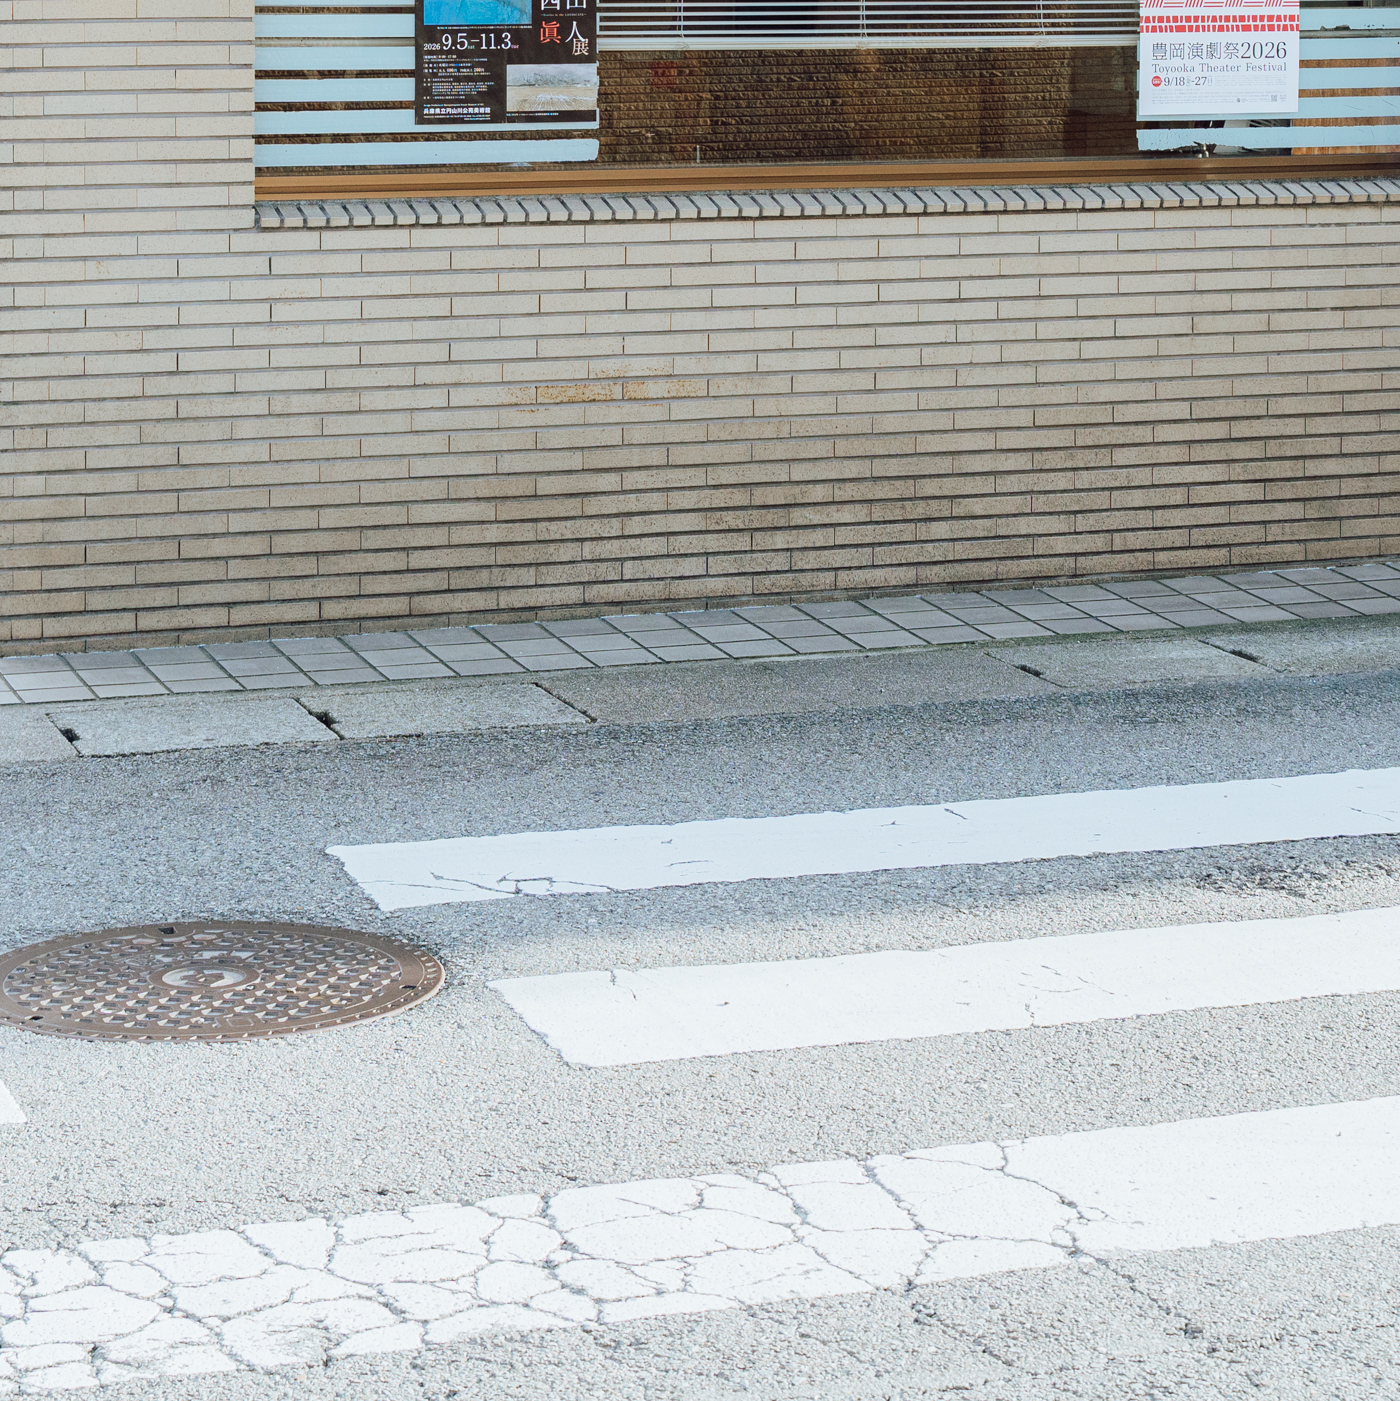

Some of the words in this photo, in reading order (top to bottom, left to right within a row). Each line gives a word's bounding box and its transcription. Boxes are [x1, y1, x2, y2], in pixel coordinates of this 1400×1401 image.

[423, 43, 441, 51] 2026
[1152, 41, 1287, 60] 豊岡演劇祭2026
[1152, 63, 1195, 75] Toyooka
[1199, 62, 1241, 72] Theater
[1245, 62, 1287, 72] Festival
